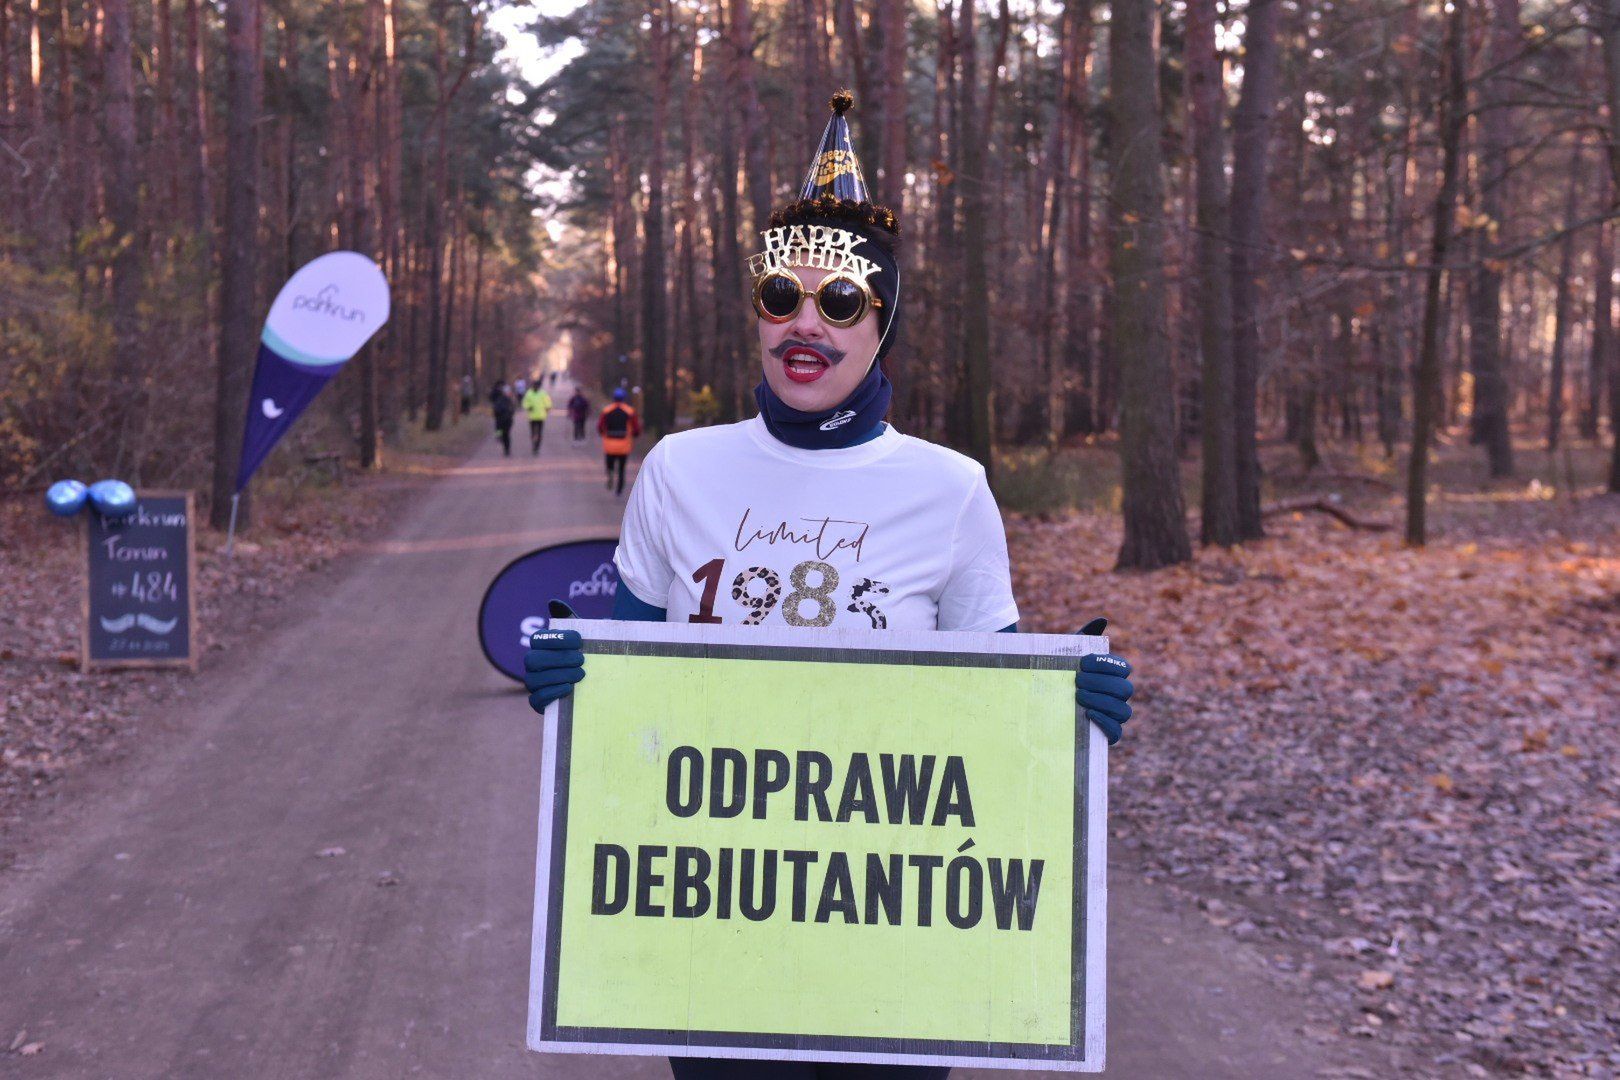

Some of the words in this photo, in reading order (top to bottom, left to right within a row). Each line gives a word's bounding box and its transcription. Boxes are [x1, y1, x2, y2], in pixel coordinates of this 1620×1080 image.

[760, 224, 868, 252] HAPPY
[744, 245, 883, 278] BIRTHDAY
[292, 293, 366, 323] parkrun
[568, 572, 618, 599] park
[533, 632, 564, 640] INBIKE
[666, 745, 976, 828] ODPRAWA
[591, 837, 1045, 931] DEBIUTANTÓW
